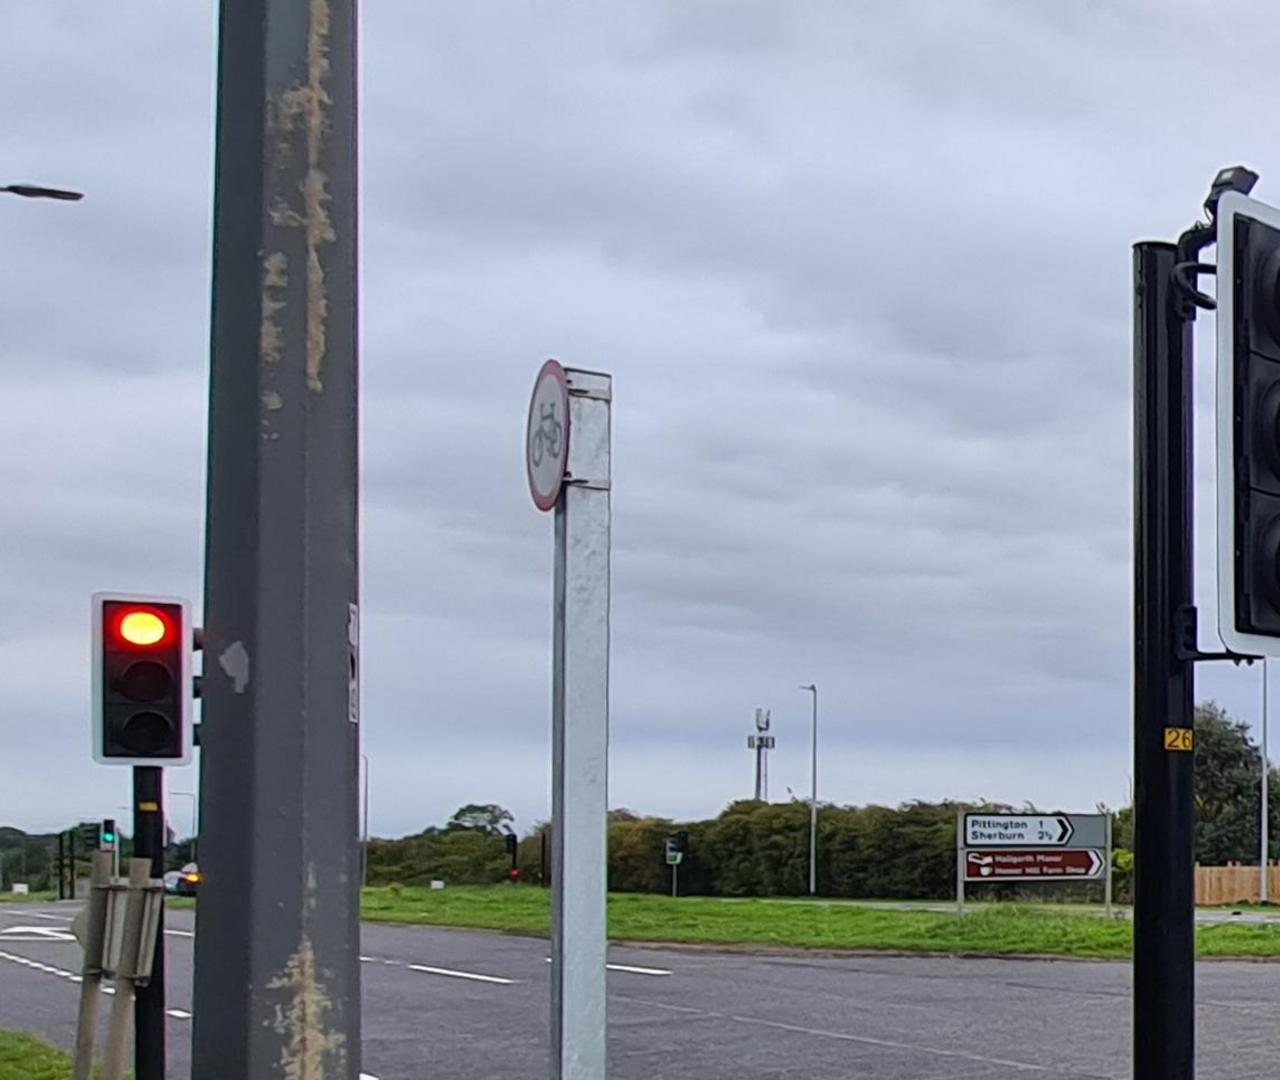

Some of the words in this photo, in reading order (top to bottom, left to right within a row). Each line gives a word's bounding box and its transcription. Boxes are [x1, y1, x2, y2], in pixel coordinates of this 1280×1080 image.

[1167, 729, 1191, 748] 26
[971, 819, 1028, 830] Pittington
[1039, 819, 1044, 829] 1
[971, 830, 1025, 841] Sherburn
